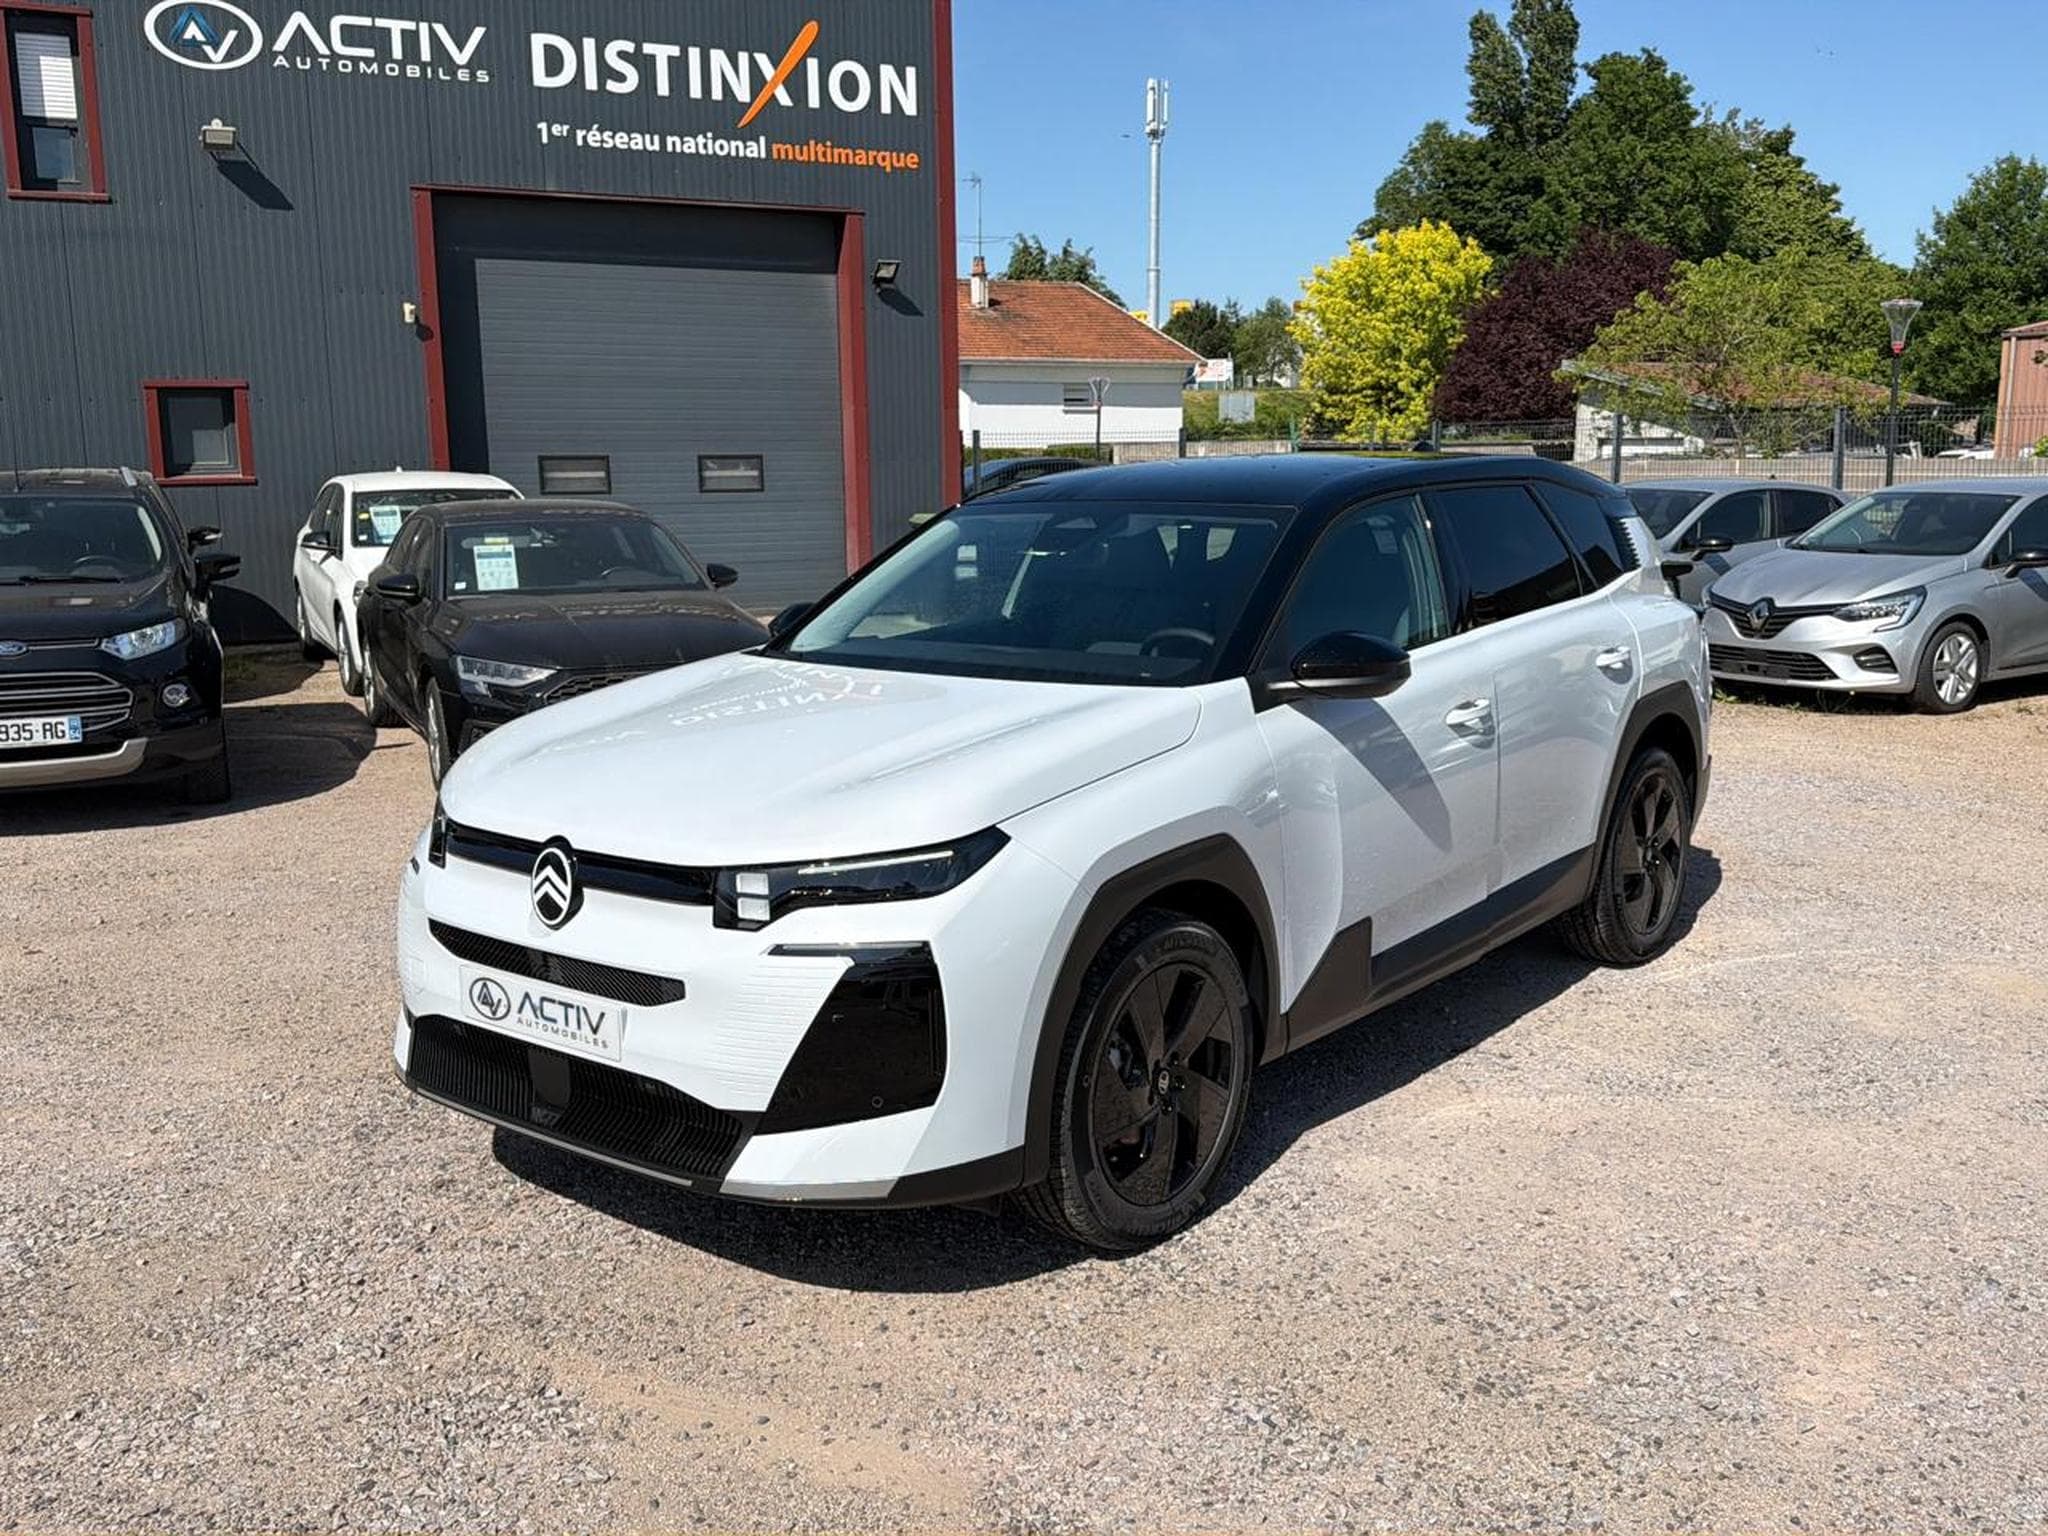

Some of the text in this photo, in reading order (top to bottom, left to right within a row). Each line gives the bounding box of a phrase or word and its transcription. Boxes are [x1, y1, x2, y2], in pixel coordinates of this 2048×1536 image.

[271, 10, 487, 66] ACTIV
[272, 54, 490, 83] AUTOMOBILES
[529, 20, 919, 128] DISTINXION
[536, 122, 920, 174] 1er réseau national multimarque
[516, 1017, 609, 1049] AUTOMOBILES
[517, 991, 606, 1035] ACTIV
